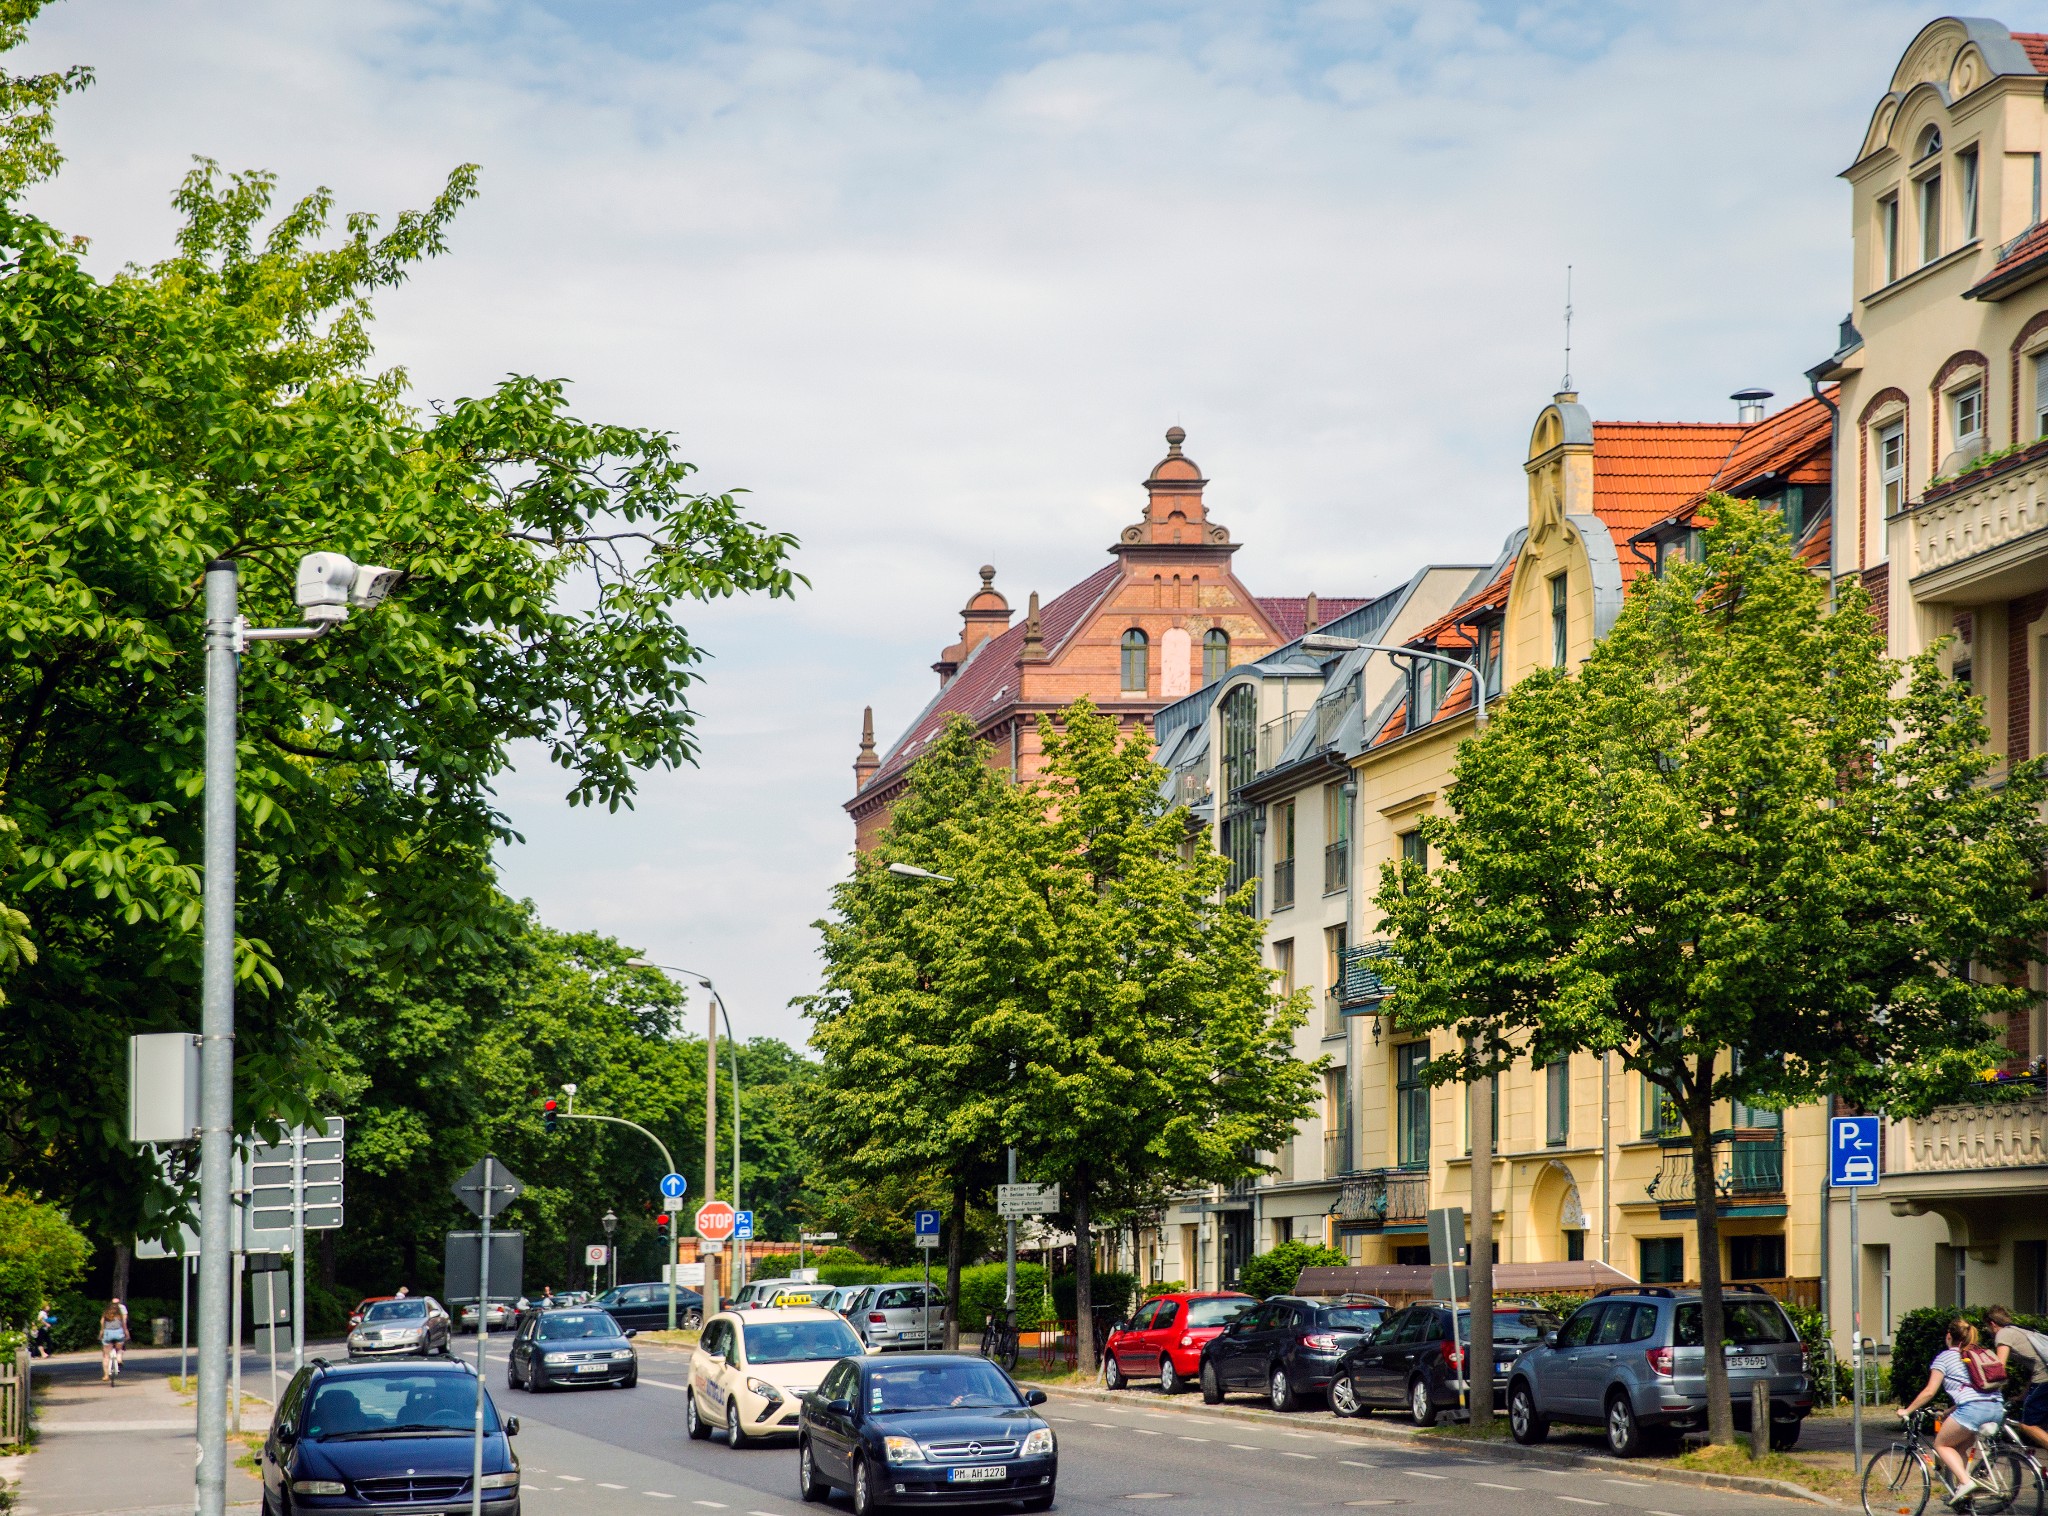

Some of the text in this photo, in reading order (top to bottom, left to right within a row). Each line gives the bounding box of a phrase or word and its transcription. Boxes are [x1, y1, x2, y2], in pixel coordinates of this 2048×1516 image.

[1839, 1122, 1860, 1149] P
[700, 1213, 733, 1229] STOP
[736, 1213, 745, 1225] P
[921, 1213, 934, 1231] P
[781, 1295, 810, 1303] TAXI
[1744, 1356, 1766, 1366] 9696
[954, 1467, 1005, 1479] PM AH 1278
